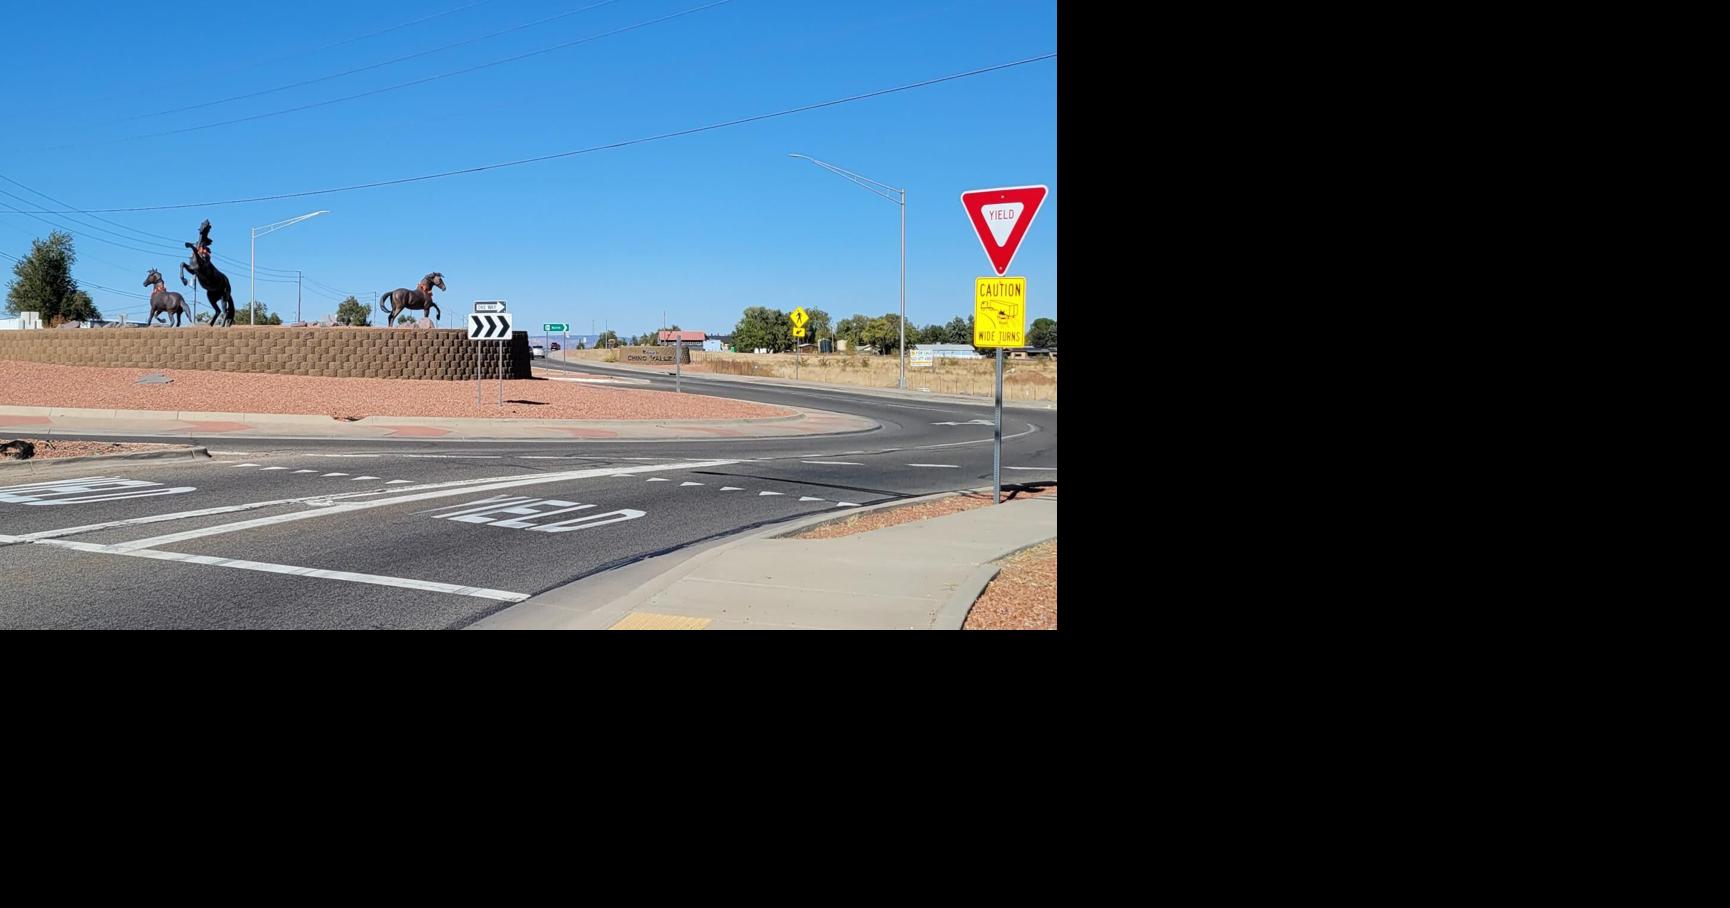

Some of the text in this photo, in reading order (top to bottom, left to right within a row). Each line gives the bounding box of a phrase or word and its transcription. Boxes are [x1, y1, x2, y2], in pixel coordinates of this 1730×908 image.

[989, 209, 1015, 221] YIELD
[979, 283, 1021, 298] CAUTION
[978, 331, 1021, 343] WIDE TURNS
[408, 494, 647, 533] YIELD
